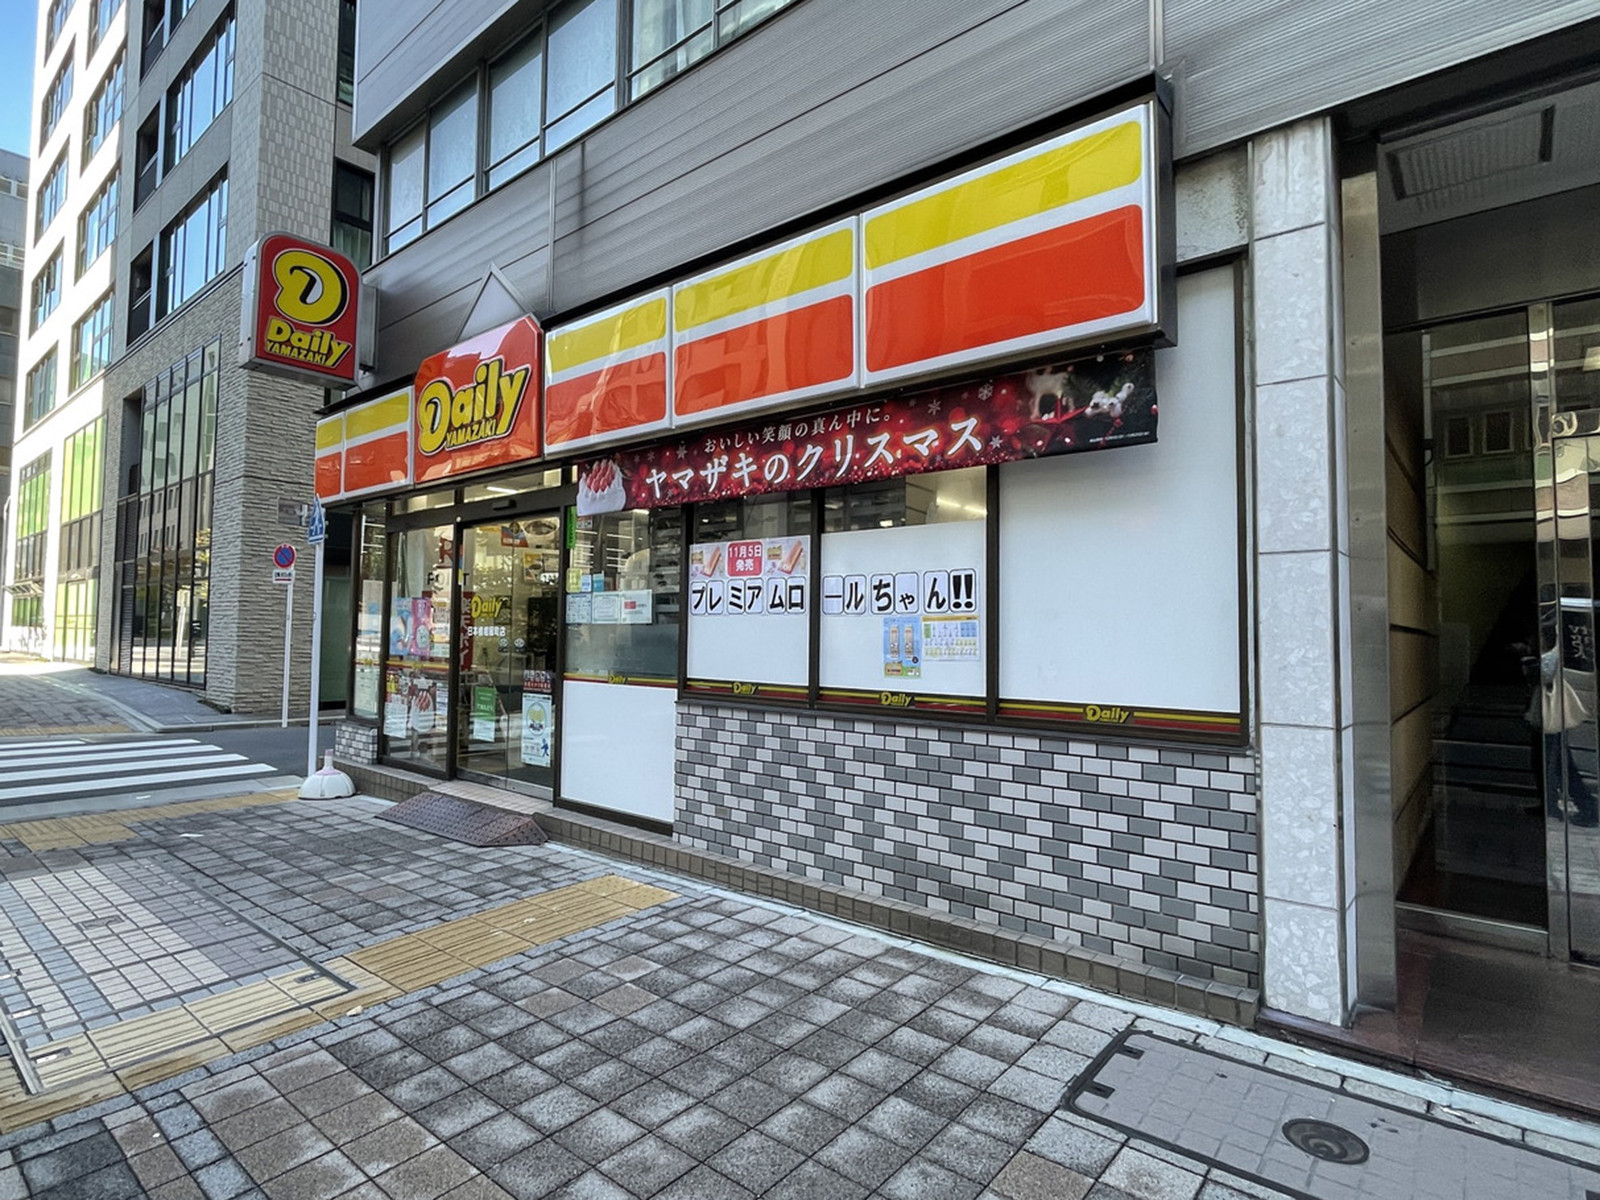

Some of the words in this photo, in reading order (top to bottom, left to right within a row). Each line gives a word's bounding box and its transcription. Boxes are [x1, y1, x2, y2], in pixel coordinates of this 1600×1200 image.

[266, 341, 327, 364] YAMAZAKI
[267, 318, 350, 367] Daily
[420, 358, 528, 453] Daily
[446, 418, 497, 447] YAMAZAKI
[705, 407, 891, 453] おいしい笑顔の真ん中に。
[646, 416, 983, 499] ヤマザキのクリスマス
[728, 544, 762, 558] 11月5日
[735, 558, 754, 572] 発売
[471, 595, 502, 618] Daily
[732, 681, 757, 695] Daily
[880, 691, 912, 707] Daily
[1085, 705, 1130, 723] Daily
